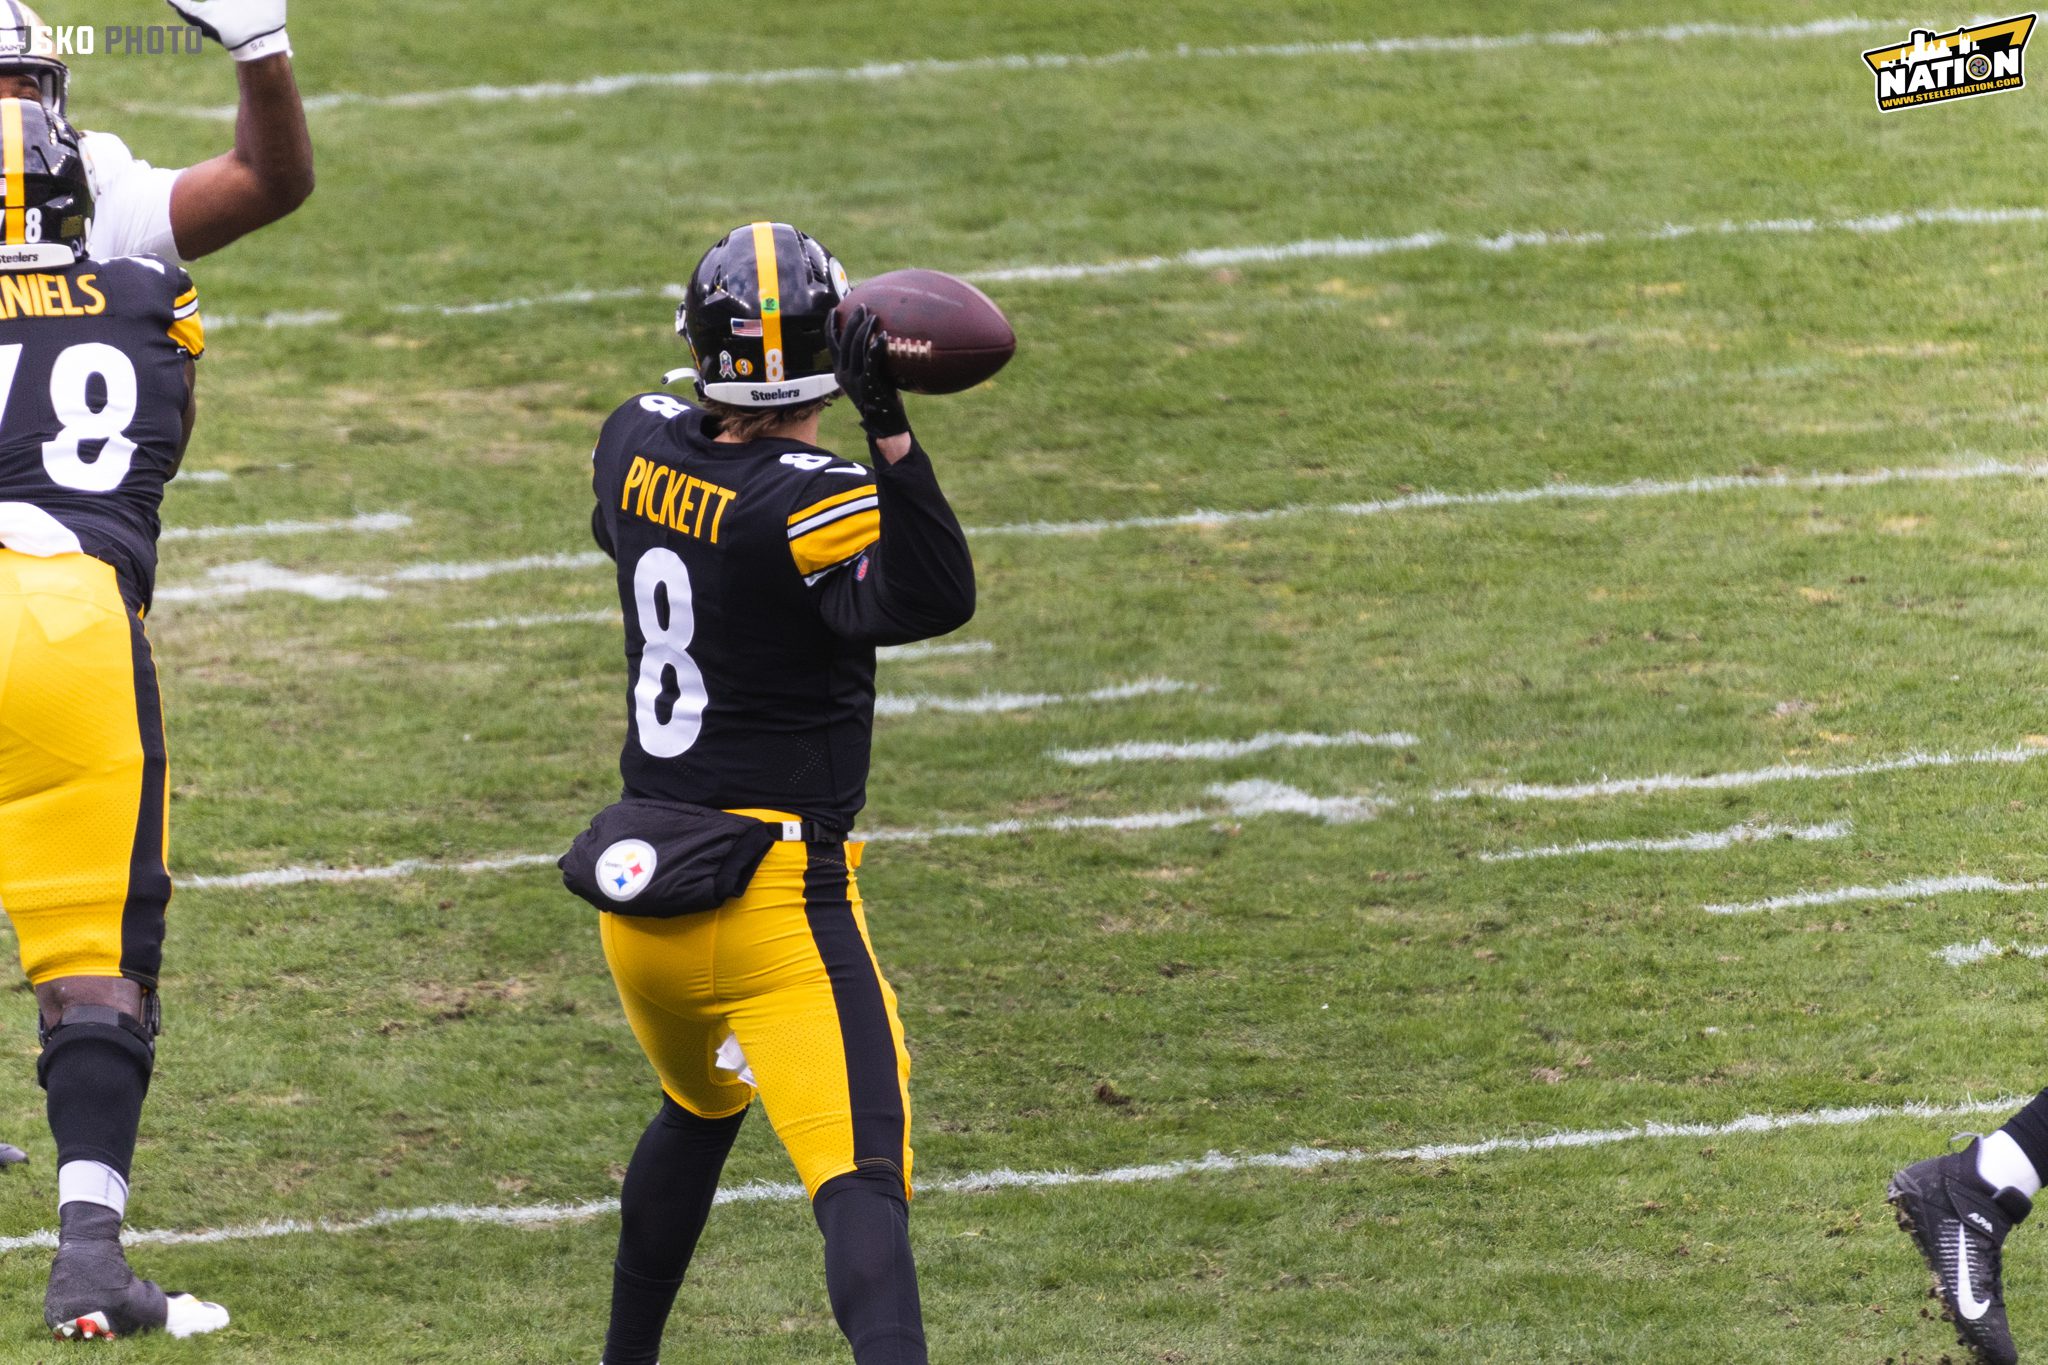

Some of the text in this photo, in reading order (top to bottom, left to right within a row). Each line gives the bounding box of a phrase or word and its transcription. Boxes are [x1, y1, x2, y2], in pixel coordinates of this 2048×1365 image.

[0, 251, 39, 263] teelers
[750, 388, 800, 401] Steelers
[766, 348, 783, 381] 8
[0, 342, 138, 492] 8
[621, 456, 736, 544] PICKETT
[633, 547, 708, 758] 8
